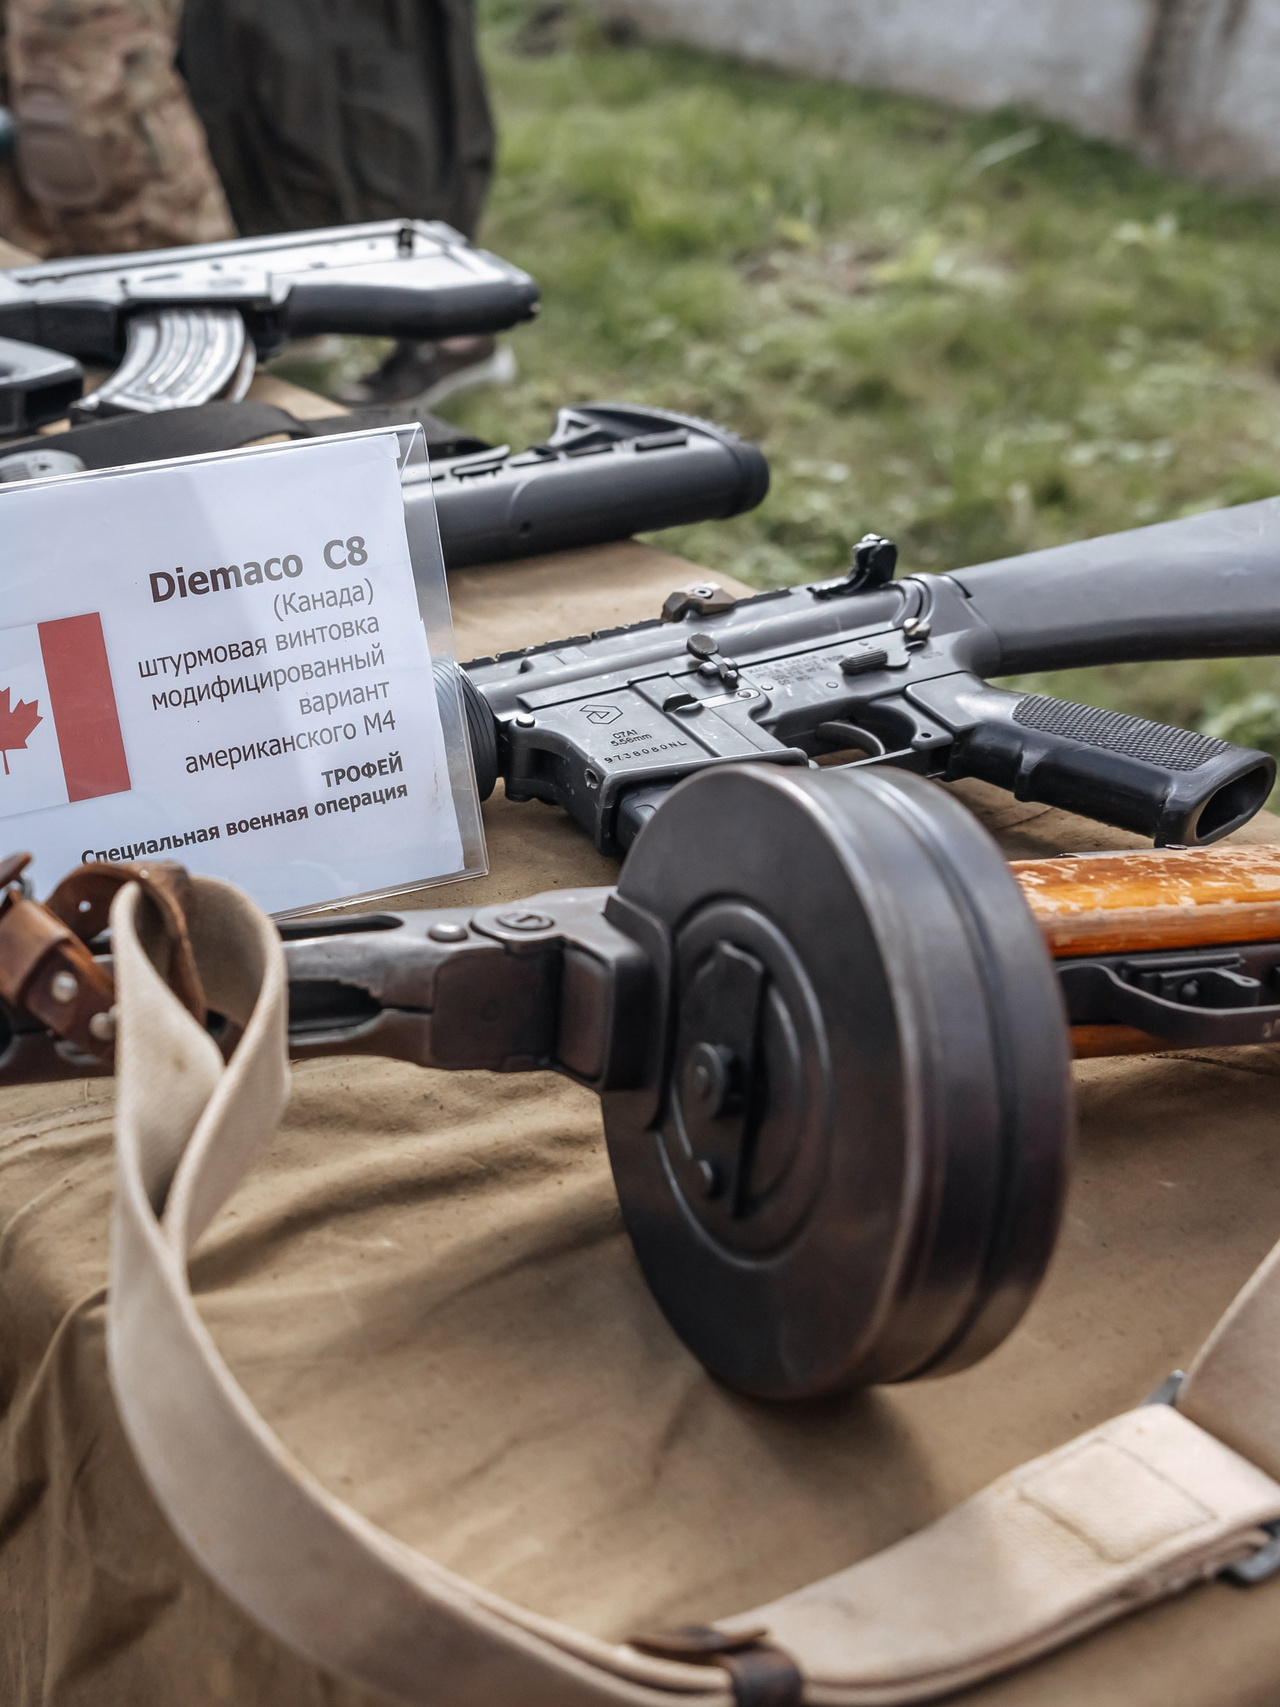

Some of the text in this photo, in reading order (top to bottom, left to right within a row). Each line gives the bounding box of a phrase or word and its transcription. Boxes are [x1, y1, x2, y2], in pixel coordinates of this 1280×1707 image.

[149, 536, 368, 603] Diemaco C8
[273, 577, 374, 622] (Канада)
[138, 616, 380, 679] штурмовая винтовка
[151, 642, 385, 711] модифицированный
[298, 681, 391, 715] вариант
[184, 722, 357, 774] американского
[321, 750, 404, 788] ТРОФЕЙ
[81, 784, 409, 865] Специальная военная операция
